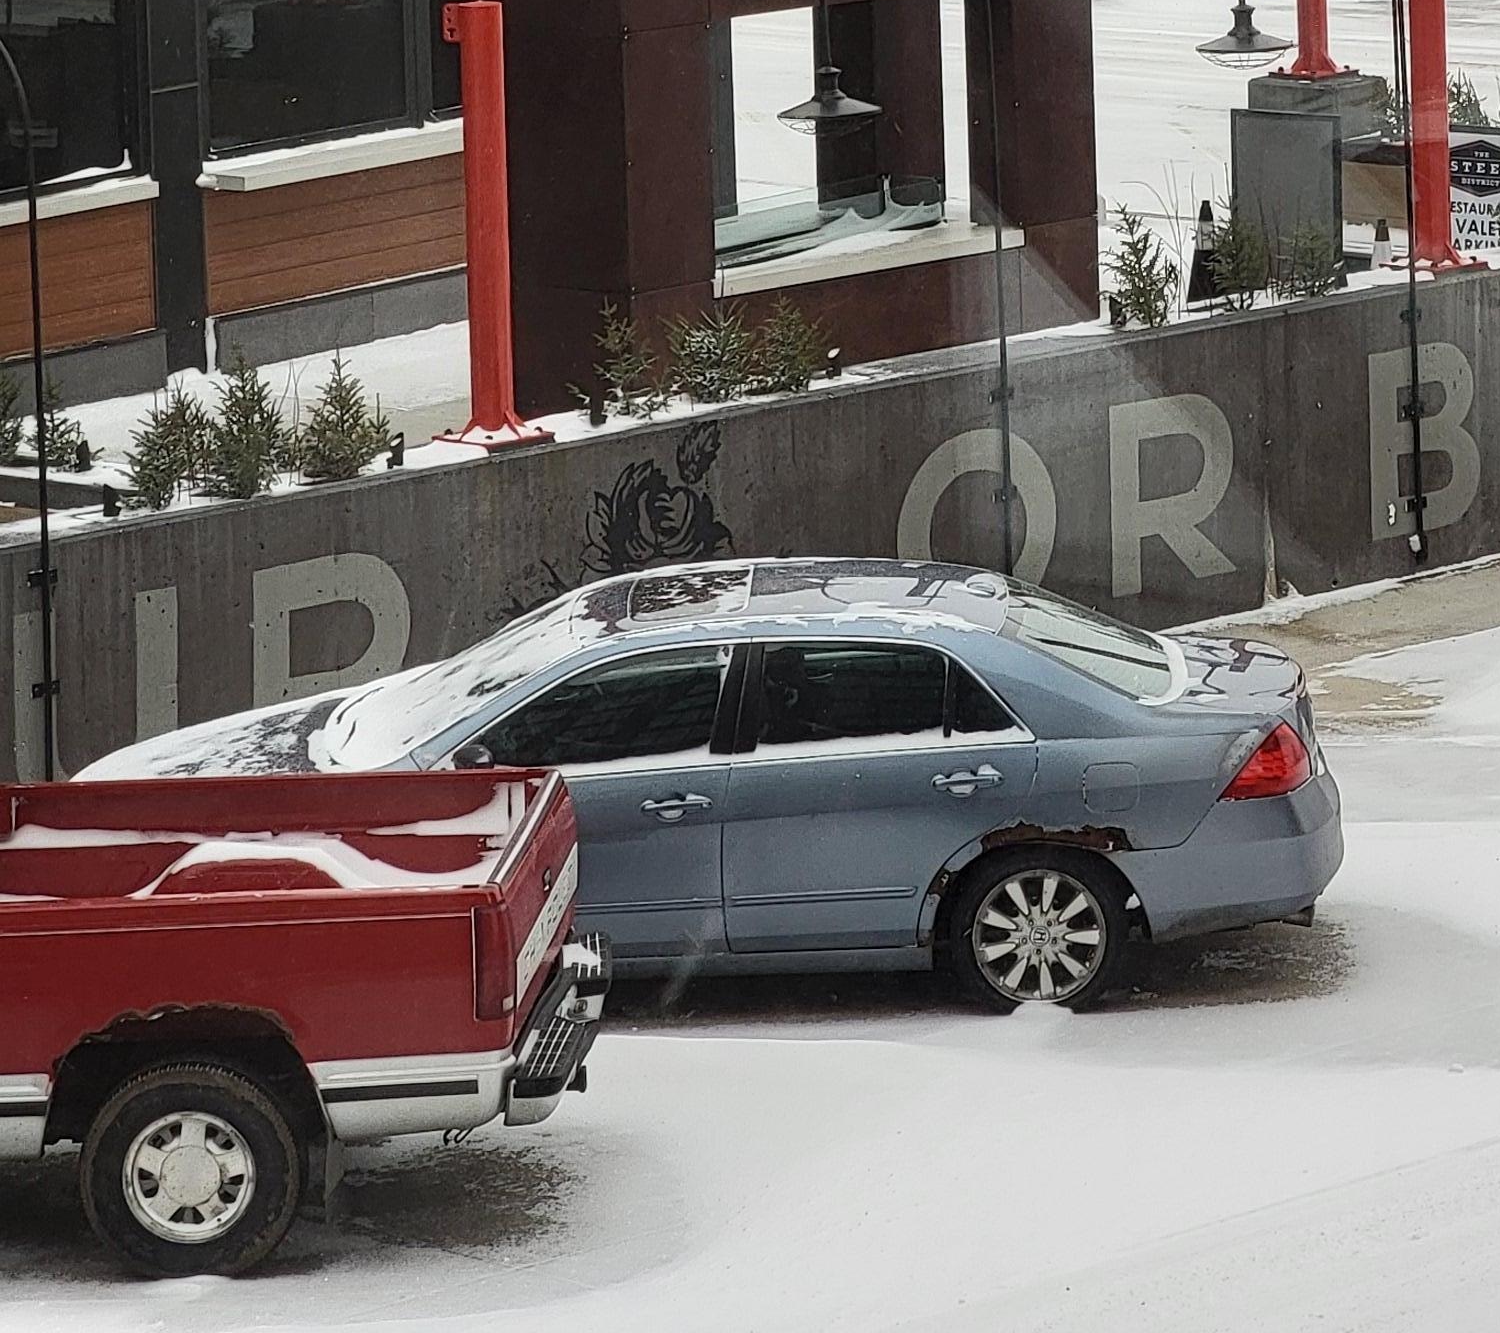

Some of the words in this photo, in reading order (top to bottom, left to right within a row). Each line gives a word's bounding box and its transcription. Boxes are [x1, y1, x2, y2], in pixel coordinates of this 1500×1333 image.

[1474, 150, 1490, 158] THE
[1461, 177, 1500, 187] DISTRICT
[897, 393, 1238, 599] OR
